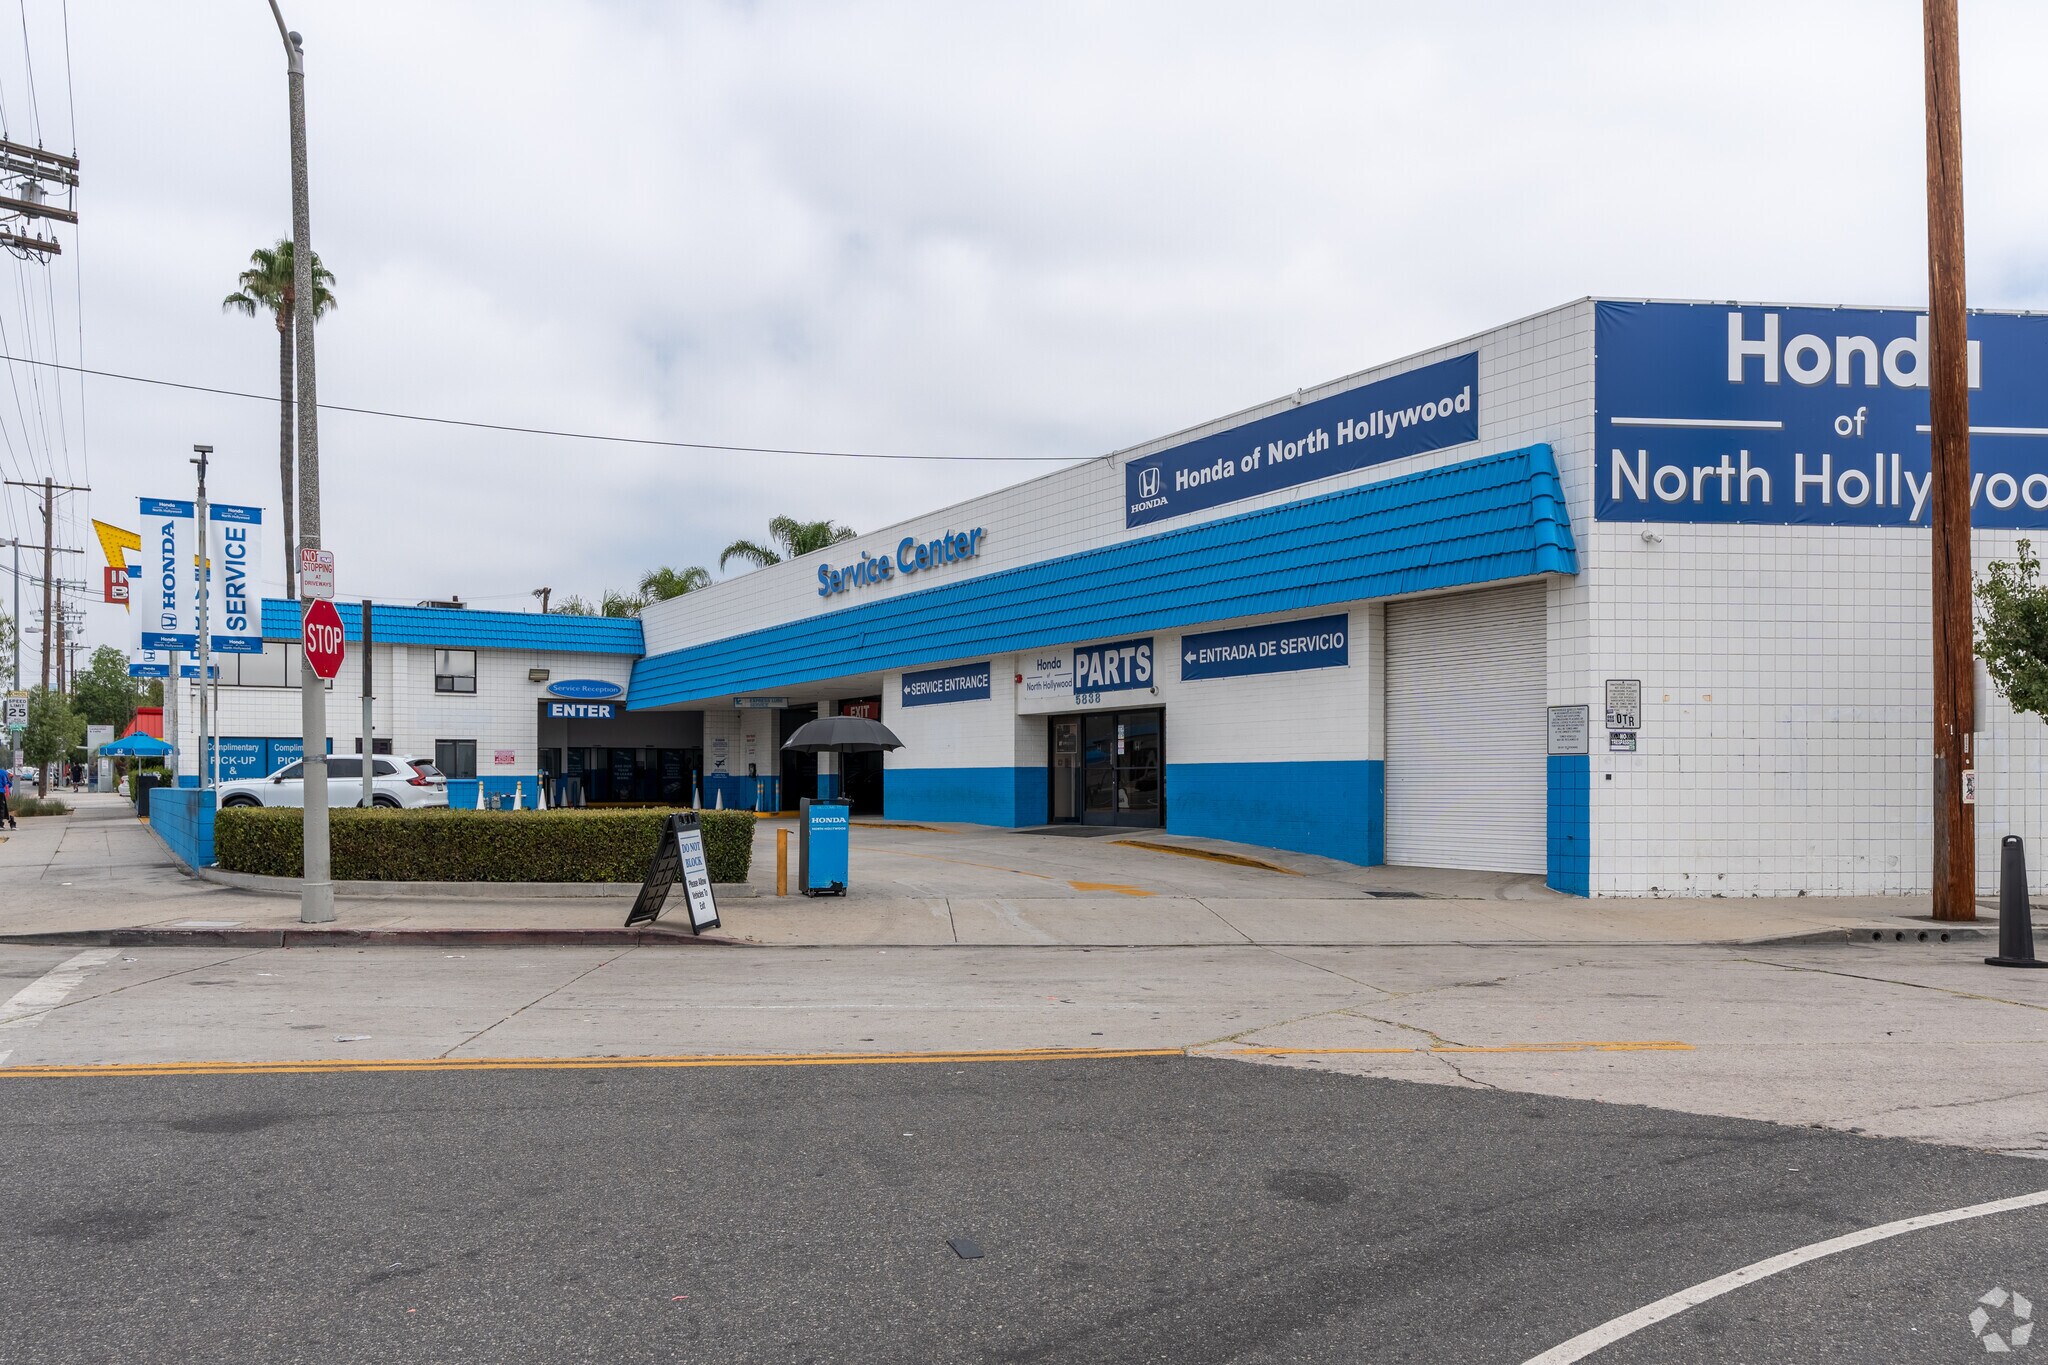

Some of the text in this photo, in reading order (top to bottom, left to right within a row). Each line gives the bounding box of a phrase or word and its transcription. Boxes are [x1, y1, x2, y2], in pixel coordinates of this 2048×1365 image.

[1727, 311, 1981, 390] Hond
[1834, 406, 1867, 436] of
[1175, 386, 1471, 492] Honda of North Hollywood
[1610, 448, 2048, 522] North Hollyoo
[1131, 496, 1169, 514] HONDA
[303, 549, 317, 562] NO
[818, 527, 987, 597] Service Center
[162, 520, 176, 610] HONDA
[303, 561, 333, 574] STOPPING
[225, 526, 248, 632] SERVICE
[304, 579, 333, 588] DRIVEWAYS
[307, 622, 342, 655] STOP
[1199, 632, 1345, 664] ENTRADA DE SERVICIO
[1036, 656, 1062, 671] Honda
[1076, 644, 1152, 688] PARTS
[552, 684, 619, 693] Service Reception
[911, 674, 989, 696] SERVICE ENTRANCE
[1026, 678, 1073, 692] North Hollywood
[1075, 693, 1101, 705] 5838
[8, 708, 27, 717] 25
[552, 703, 611, 718] ENTER
[850, 704, 870, 718] EXIT
[210, 756, 257, 765] PCK-UP
[229, 766, 238, 775] &
[681, 841, 701, 854] DO NOT
[685, 856, 703, 868] BLOCK
[688, 877, 707, 888] Please Allow
[692, 890, 703, 900] Vehicles
